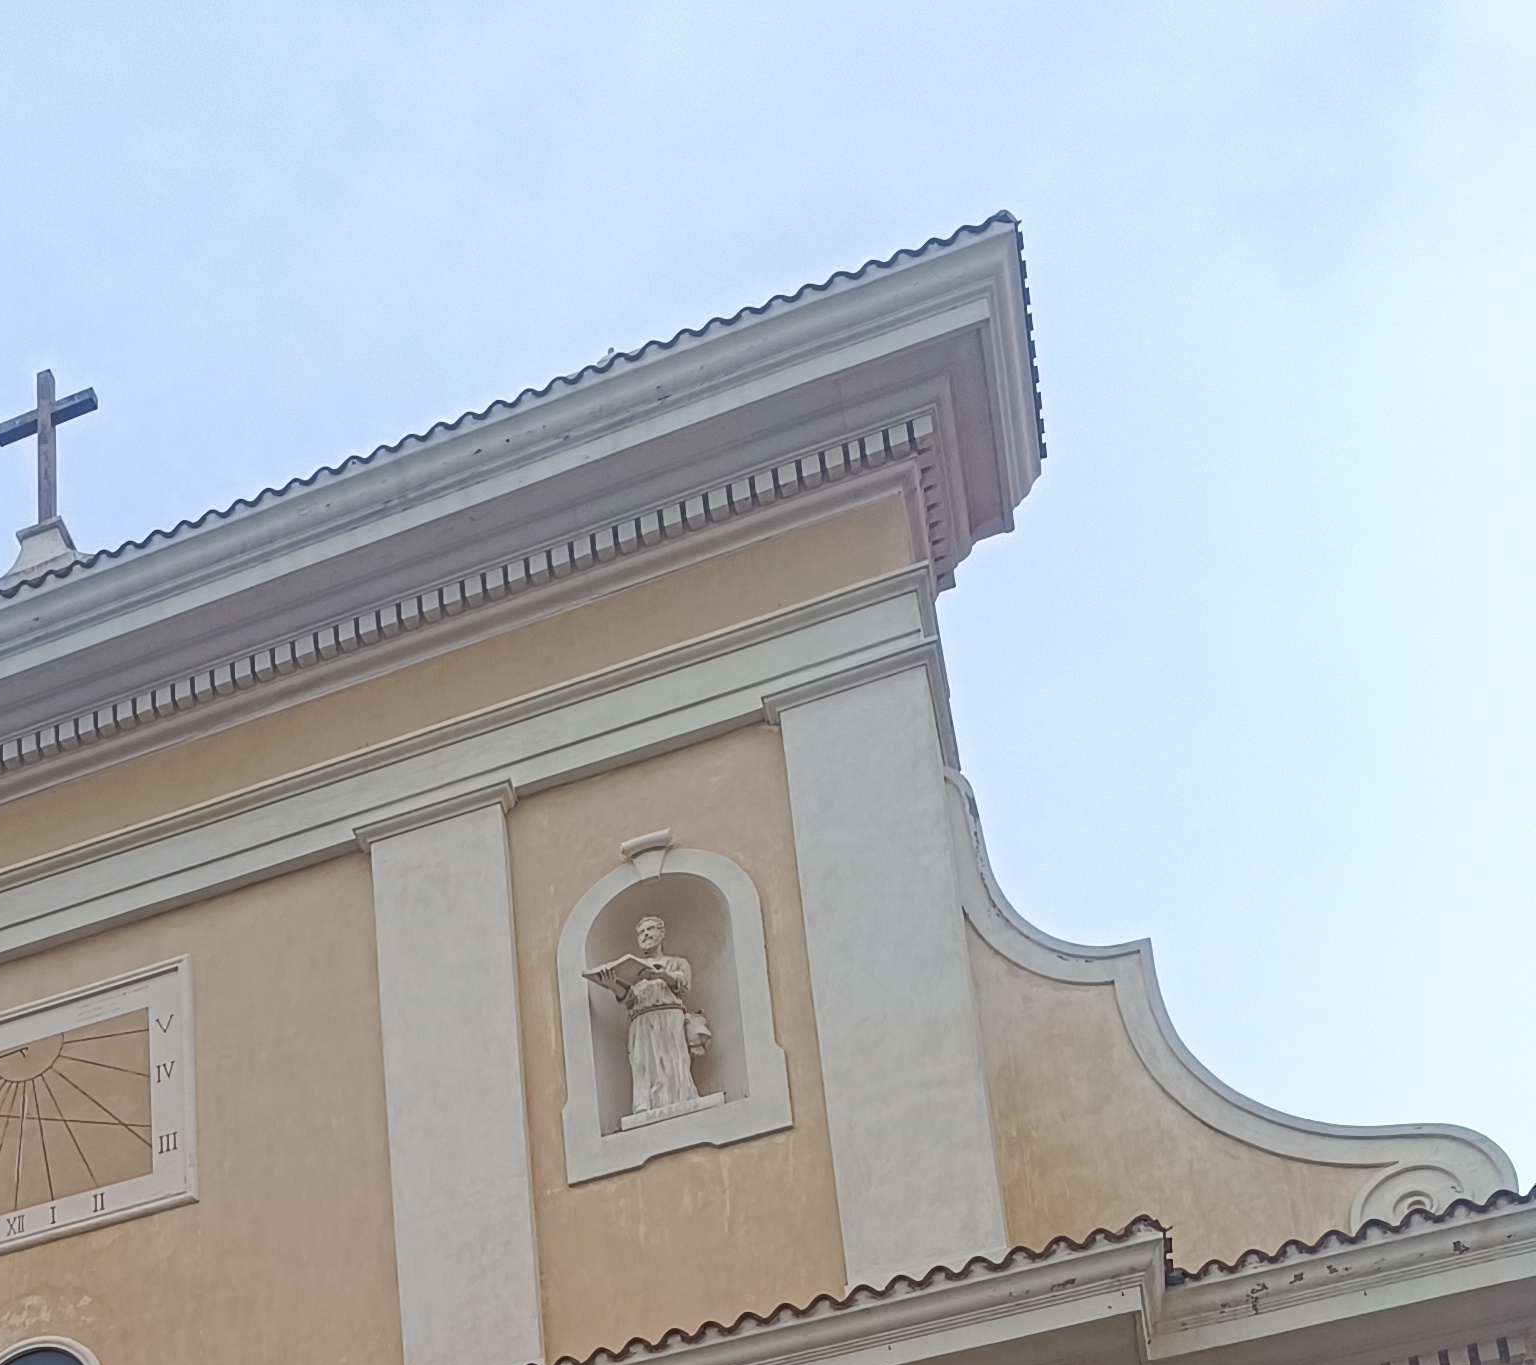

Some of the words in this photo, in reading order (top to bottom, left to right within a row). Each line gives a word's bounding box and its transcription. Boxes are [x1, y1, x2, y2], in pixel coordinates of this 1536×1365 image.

[154, 1014, 175, 1034] V
[156, 1061, 176, 1083] IV
[157, 1131, 178, 1155] III
[92, 1192, 106, 1213] II
[6, 1214, 25, 1238] XII
